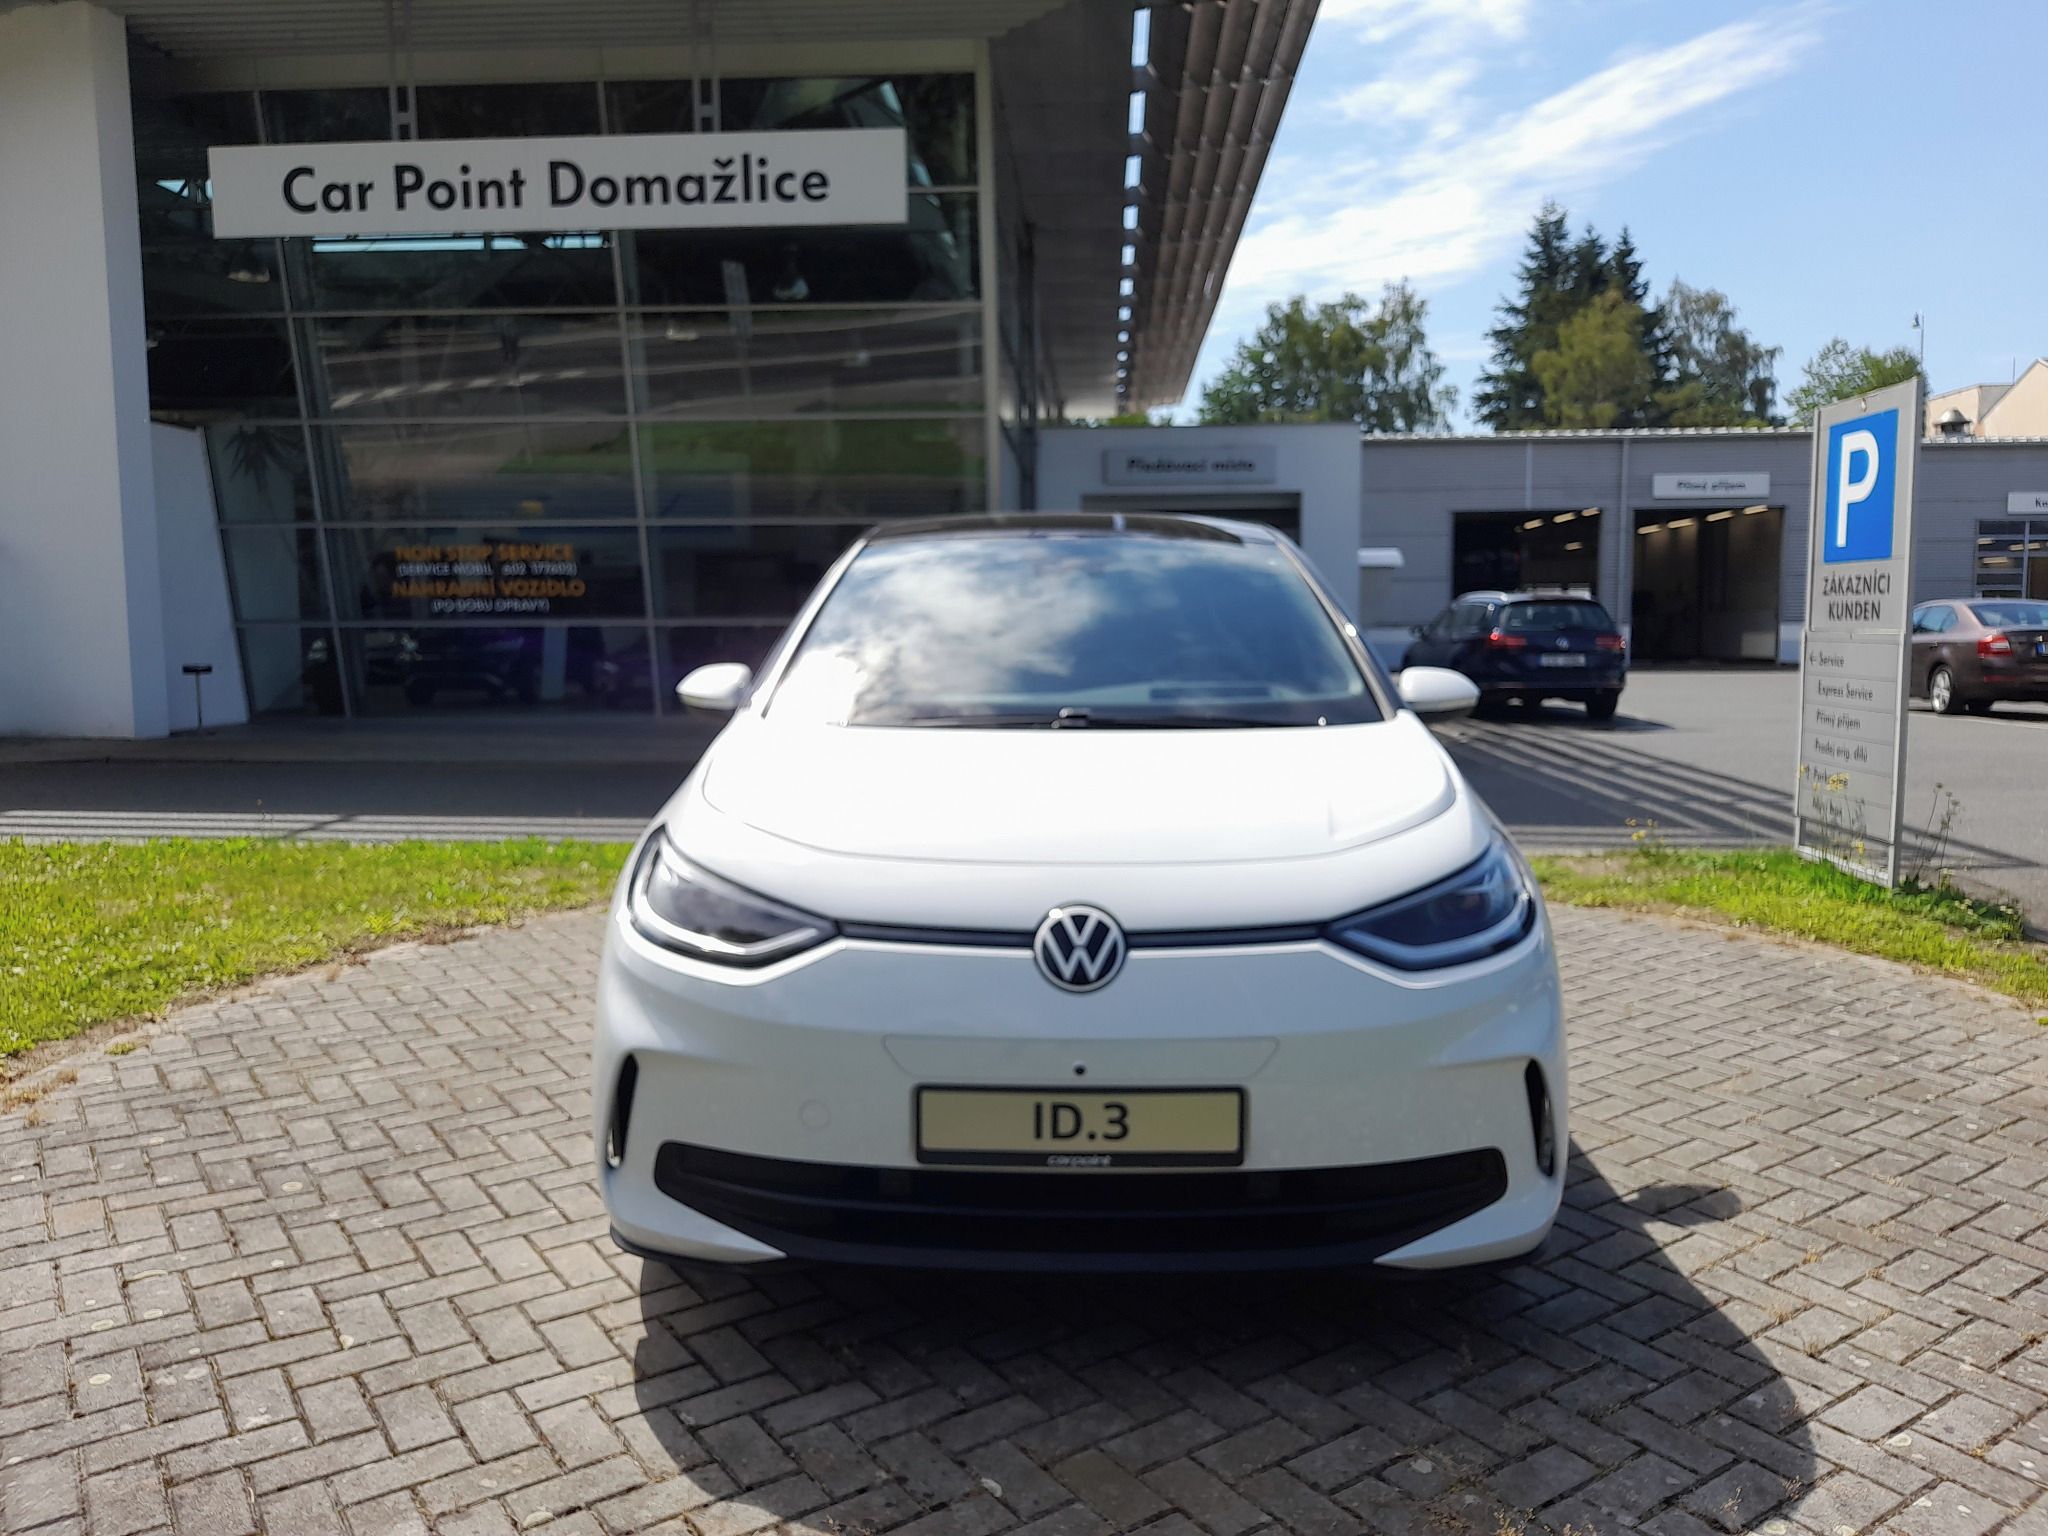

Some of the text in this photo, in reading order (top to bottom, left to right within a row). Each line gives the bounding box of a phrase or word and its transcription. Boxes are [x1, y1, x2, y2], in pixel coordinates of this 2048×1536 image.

[283, 154, 831, 214] Car Point Domažlice
[1836, 429, 1880, 548] P
[447, 543, 493, 561] STOP
[498, 543, 574, 561] SERVICE
[500, 578, 586, 598] VOZIDLO
[1823, 568, 1891, 597] ZÁKAZNÍCI
[1828, 601, 1881, 622] KUNDEN
[1819, 650, 1845, 669] Service
[1818, 680, 1874, 701] Express Service
[1033, 1102, 1130, 1140] ID.3
